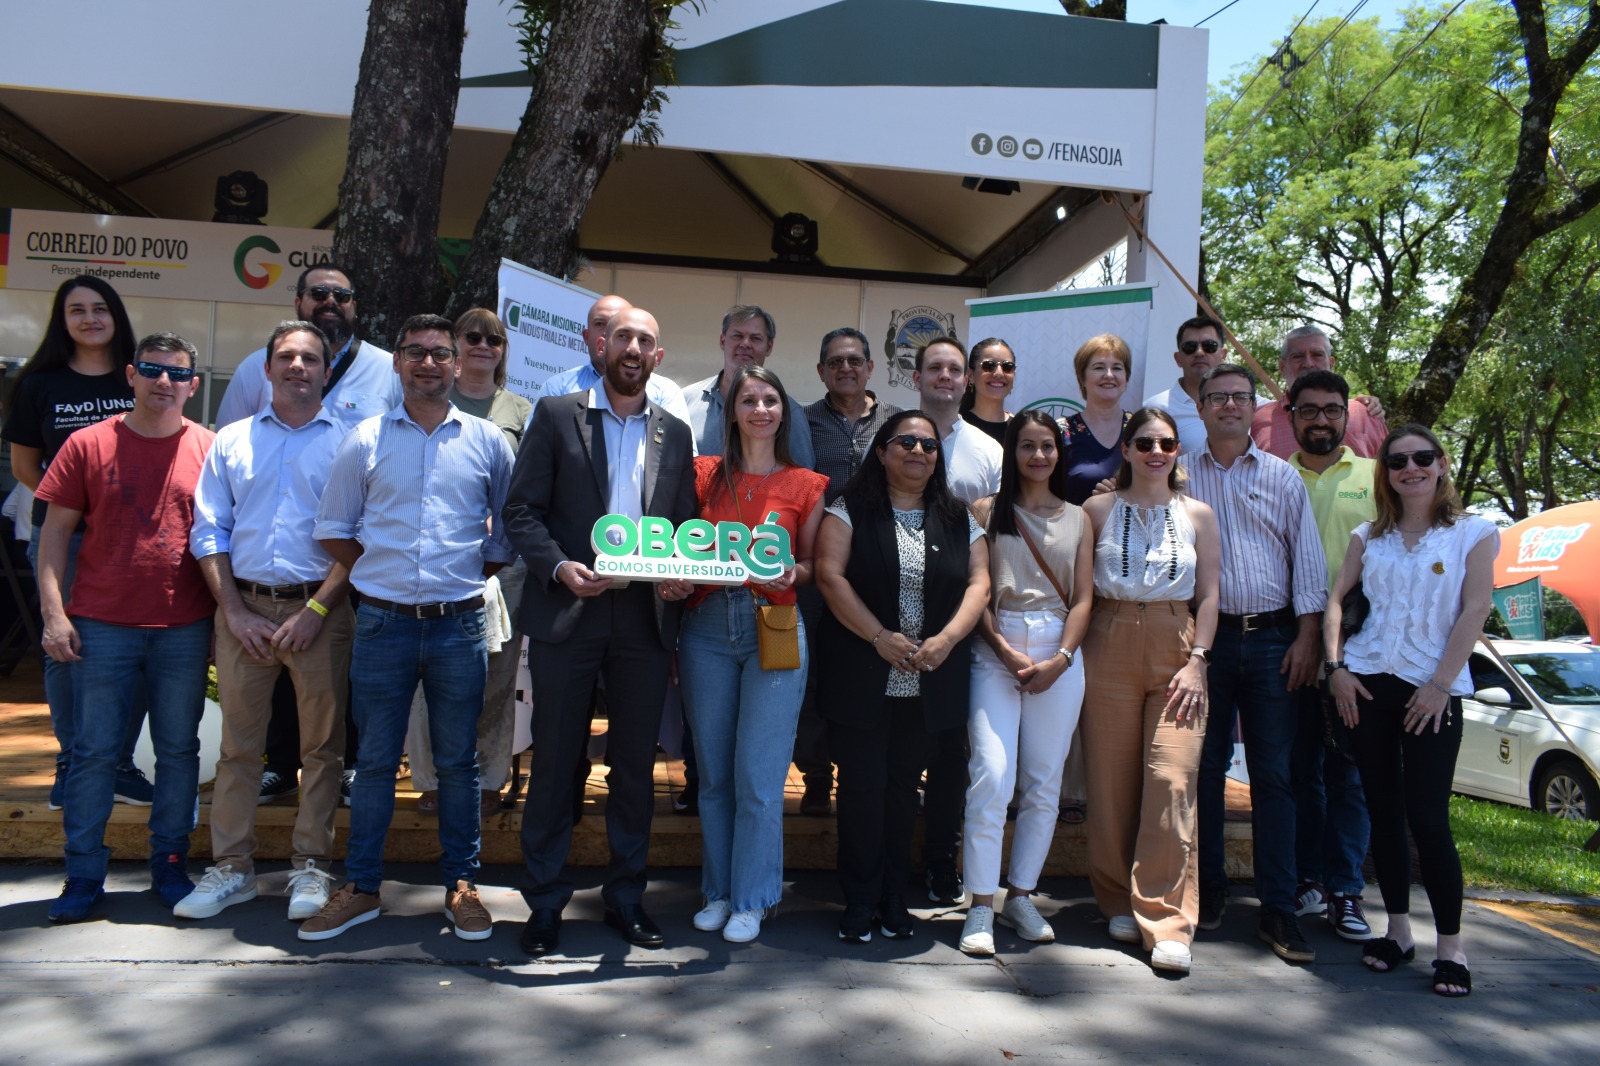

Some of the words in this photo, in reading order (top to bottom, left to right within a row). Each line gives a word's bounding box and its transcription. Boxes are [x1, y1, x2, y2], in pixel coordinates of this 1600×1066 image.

[1047, 142, 1123, 166] /FENASOJA
[26, 231, 107, 255] CORREIO
[112, 235, 136, 257] DO
[140, 238, 188, 260] POVO
[51, 264, 81, 276] Pense
[84, 266, 160, 280] independente
[521, 303, 550, 324] CÁMARA
[902, 309, 936, 320] PROVINCIA
[519, 321, 567, 347] INDUSTRIALES
[524, 356, 557, 373] Nuestros
[55, 401, 94, 414] FAyD
[55, 414, 89, 423] Facultad
[597, 560, 653, 573] SOMOS
[657, 563, 745, 577] DIVERSIDAD
